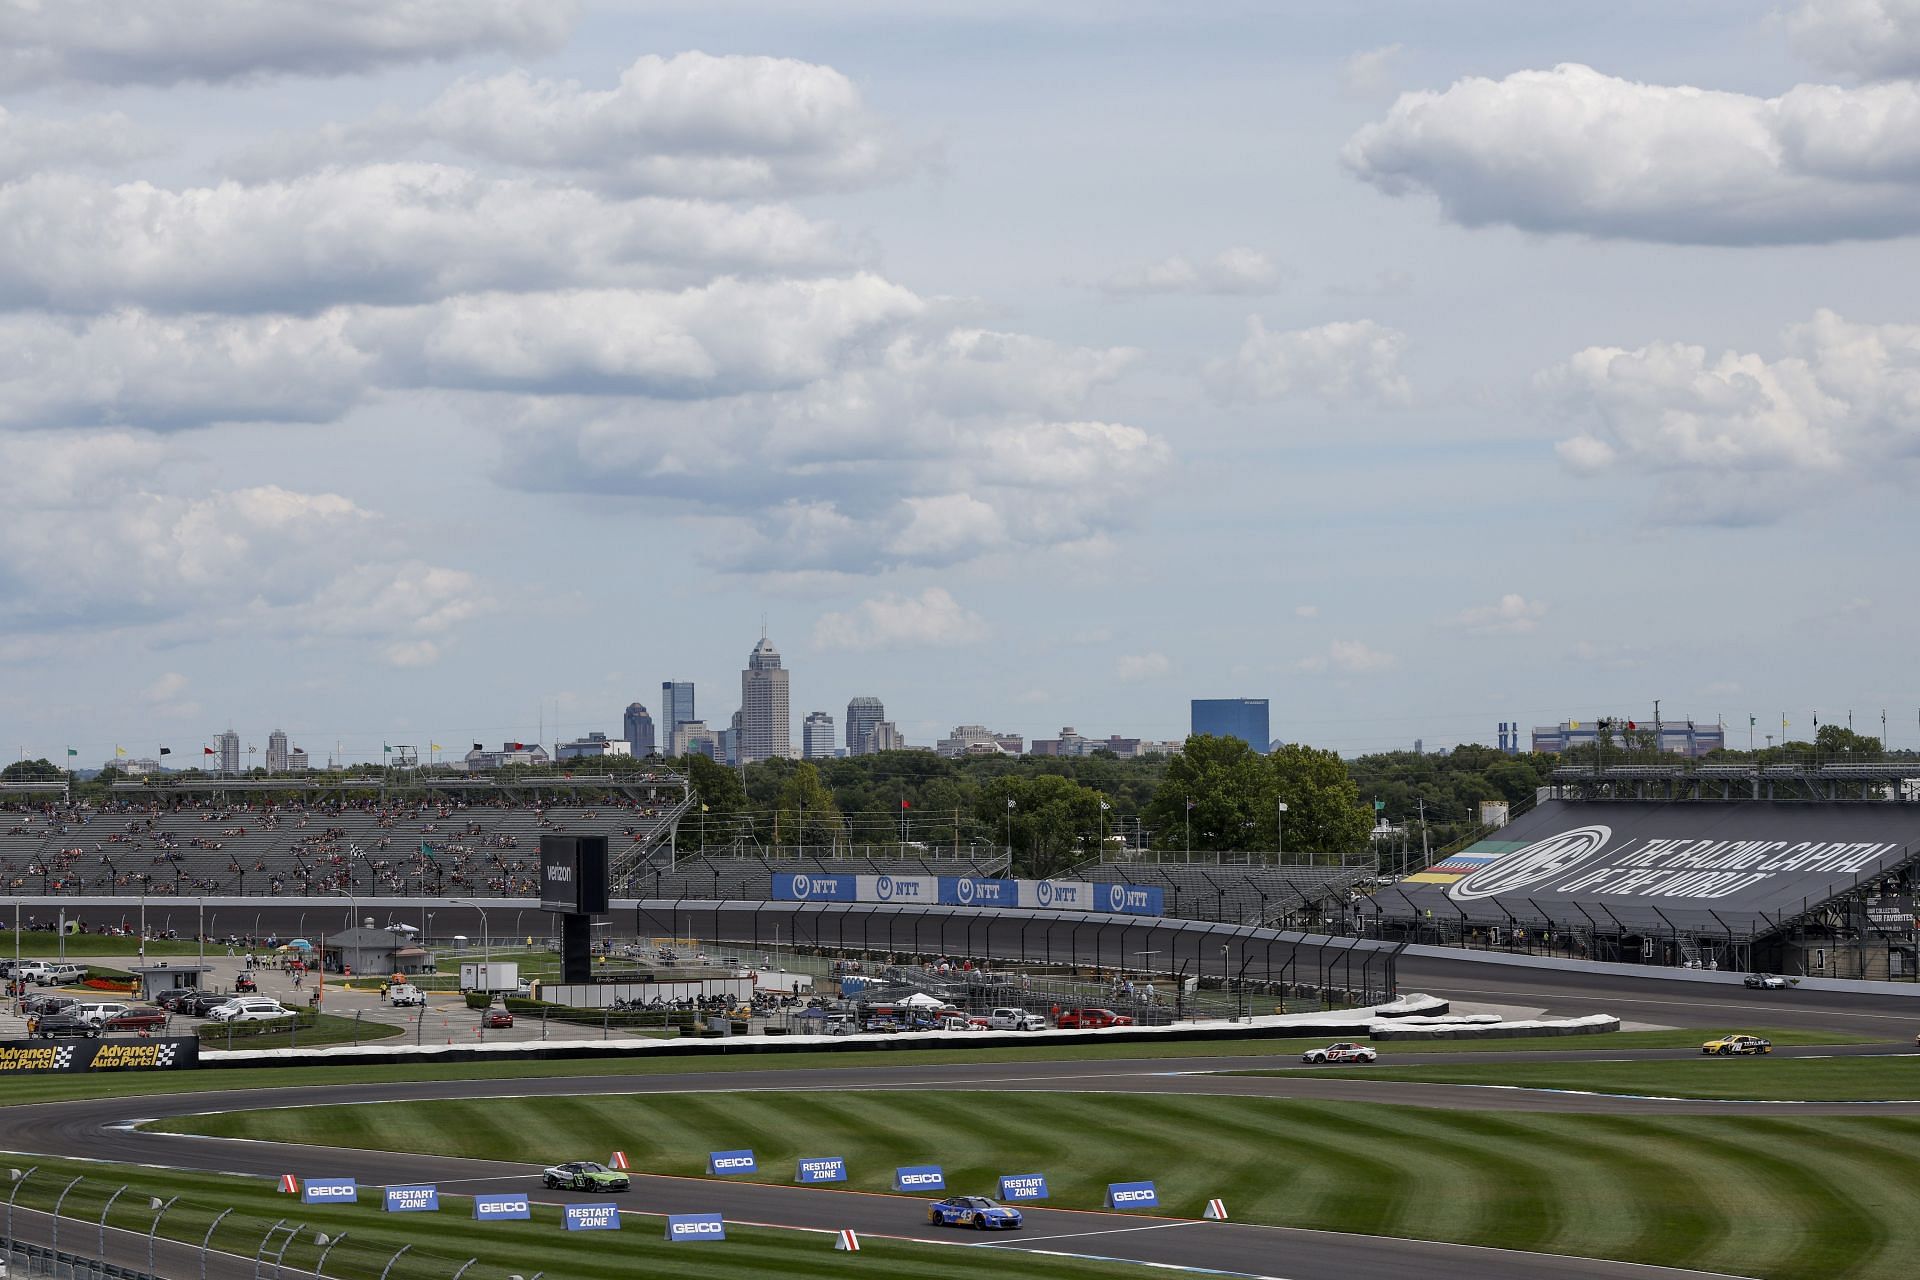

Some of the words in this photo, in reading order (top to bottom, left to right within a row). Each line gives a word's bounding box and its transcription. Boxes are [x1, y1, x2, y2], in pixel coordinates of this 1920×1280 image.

[1611, 839, 1694, 866] THE
[1657, 839, 1788, 870] RACING
[1756, 841, 1898, 872] CAPITAL
[547, 861, 571, 882] verizon
[1557, 868, 1627, 893] OF
[1591, 869, 1675, 894] THE
[812, 879, 837, 894] NTT
[895, 881, 919, 896] NTT
[976, 884, 1000, 899] NTT
[1054, 887, 1077, 903] NTT
[1126, 891, 1148, 907] NTT
[1883, 914, 1913, 922] FAVORITES
[95, 1044, 154, 1057] Advance
[17, 1058, 49, 1069] Parts
[90, 1057, 120, 1068] Auto
[120, 1056, 151, 1066] Parts
[714, 1157, 753, 1168] GEICO
[803, 1161, 842, 1171] RESTART
[813, 1170, 836, 1179] ZONE
[901, 1173, 942, 1184] GEICO
[1004, 1178, 1043, 1188] RESTART
[307, 1186, 354, 1196] GEICO
[389, 1189, 434, 1199] RESTART
[1014, 1188, 1038, 1197] ZONE
[1113, 1189, 1154, 1201] GEICO
[400, 1199, 426, 1209] ZONE
[479, 1202, 527, 1213] GEICO
[568, 1207, 615, 1218] RESTART
[960, 1208, 973, 1221] 43
[579, 1217, 607, 1227] ZONE
[672, 1222, 722, 1234] GEICO
